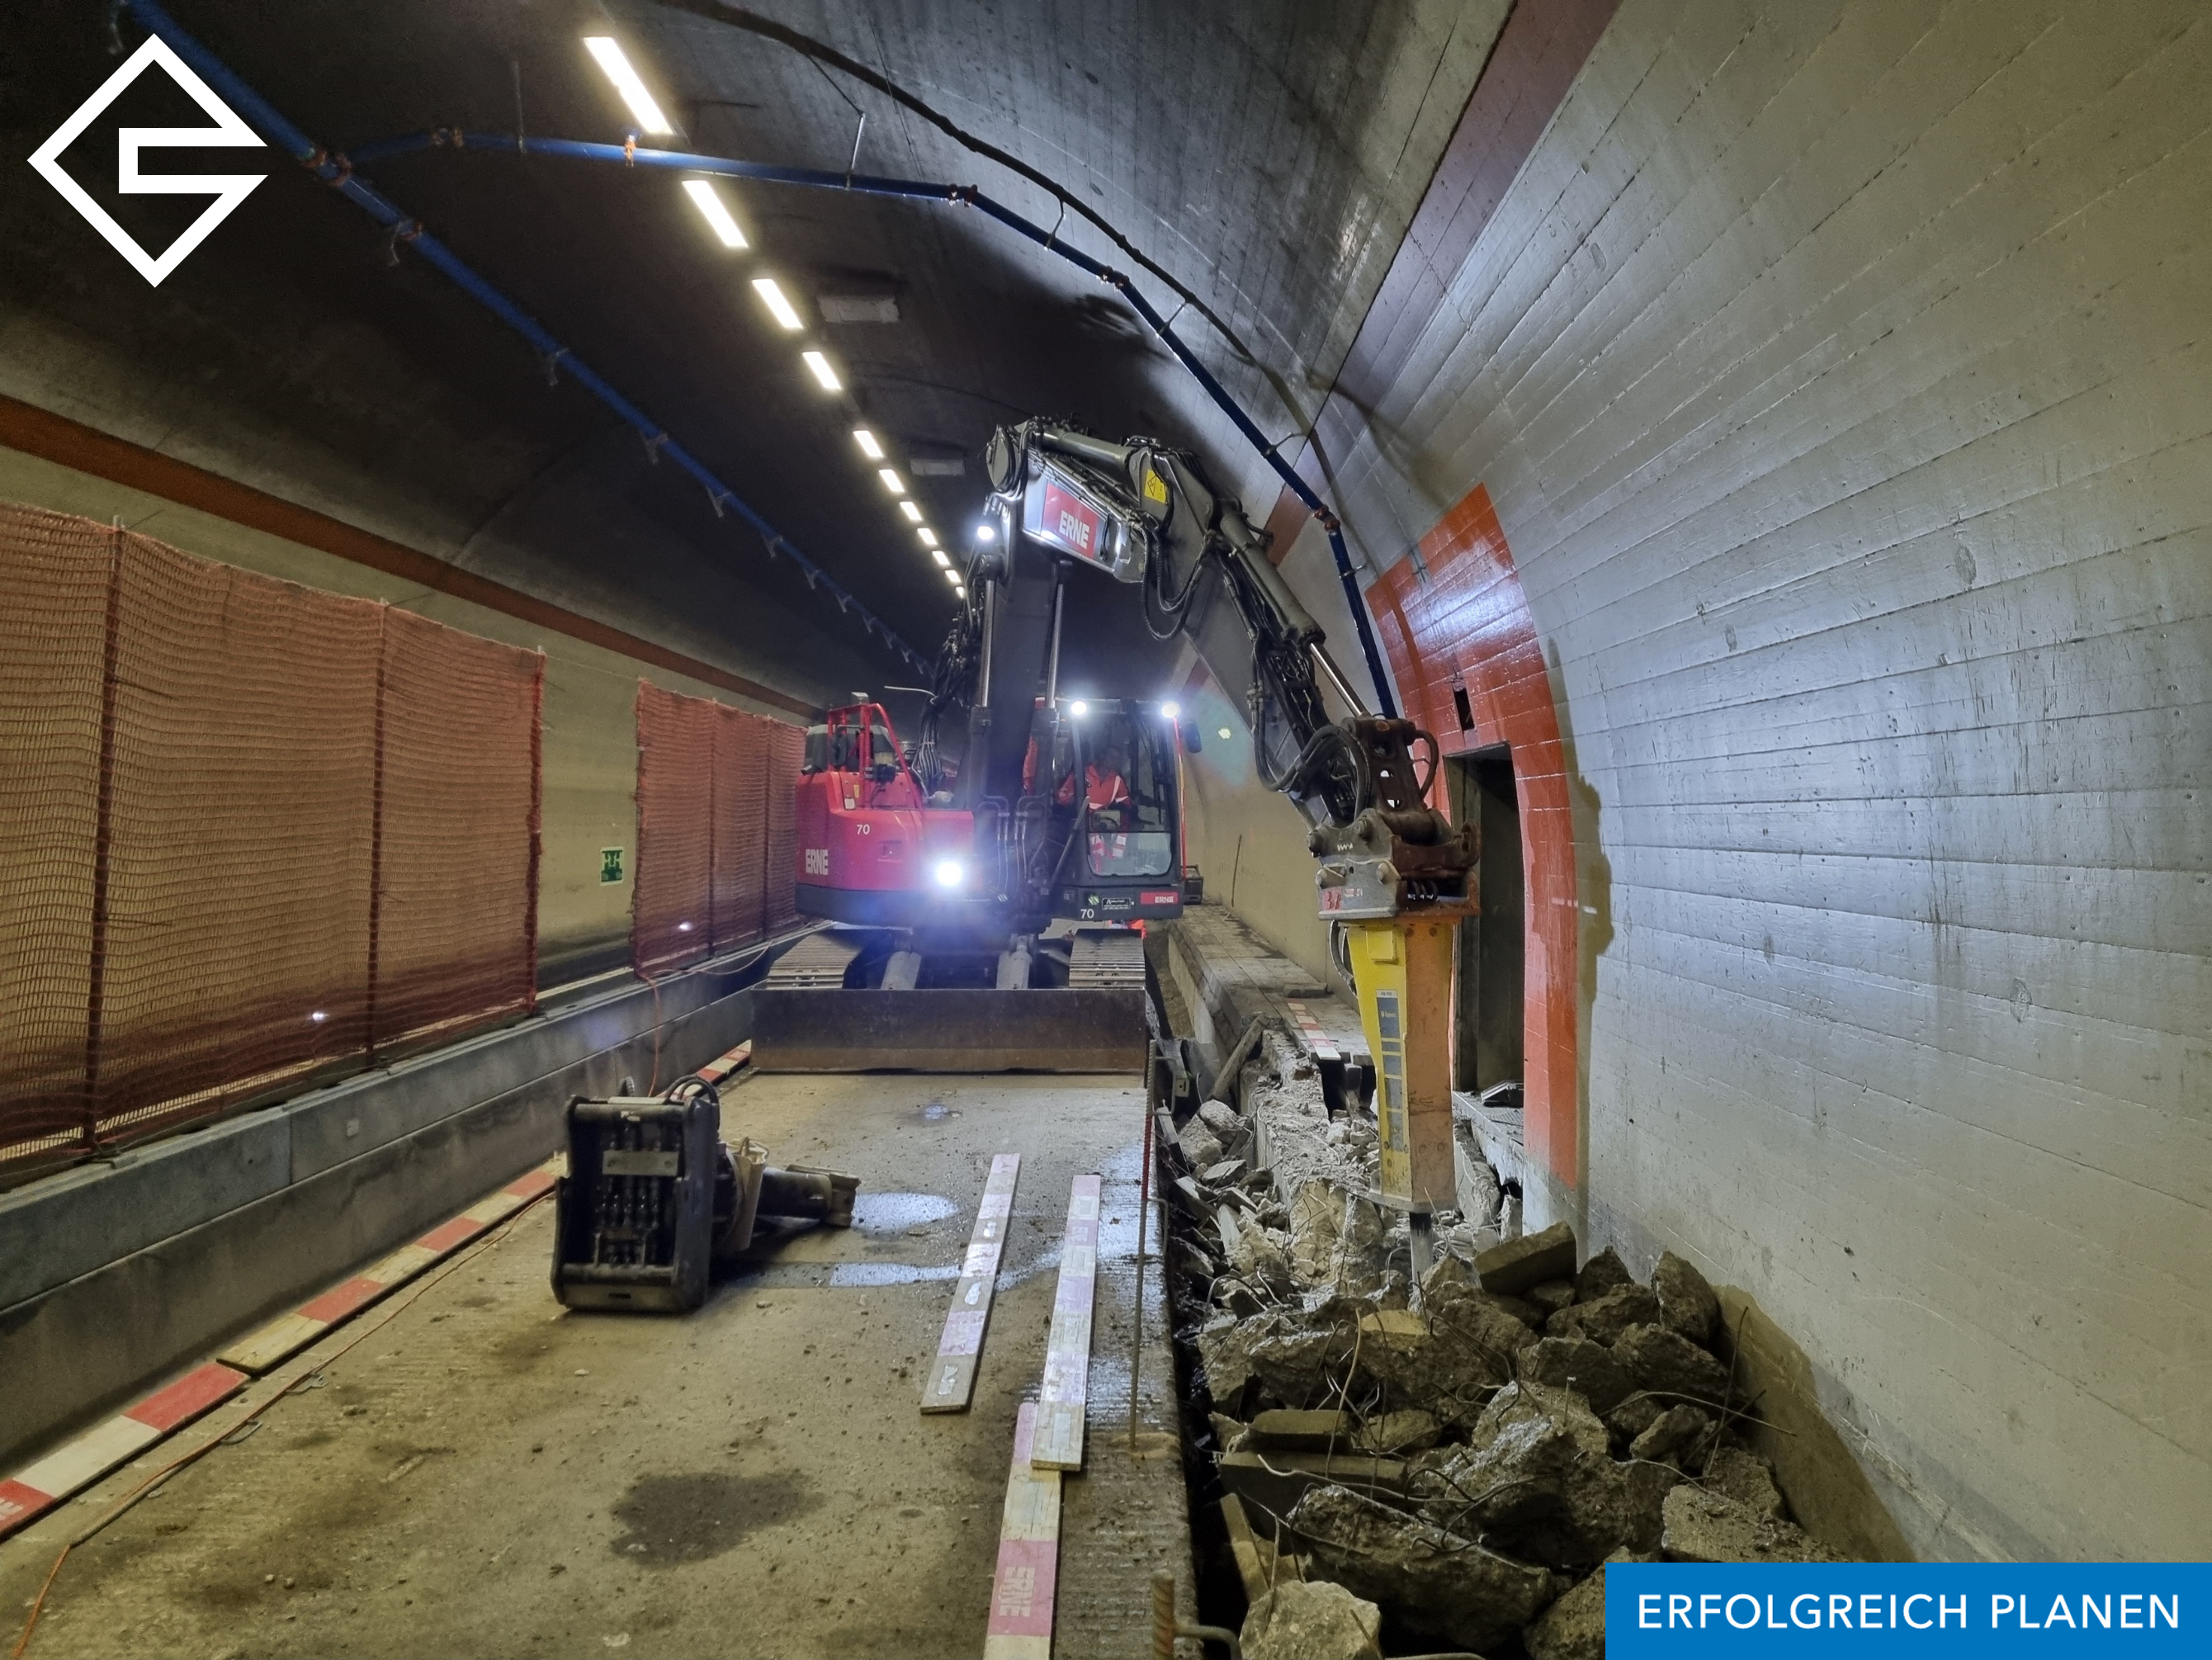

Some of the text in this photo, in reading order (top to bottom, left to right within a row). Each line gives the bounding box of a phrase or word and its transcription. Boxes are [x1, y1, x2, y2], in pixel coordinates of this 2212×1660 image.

[1059, 510, 1089, 550] ERNE
[857, 824, 870, 835] 70
[806, 849, 828, 875] ERNE
[1080, 908, 1094, 919] 70
[999, 1567, 1035, 1616] ERNE
